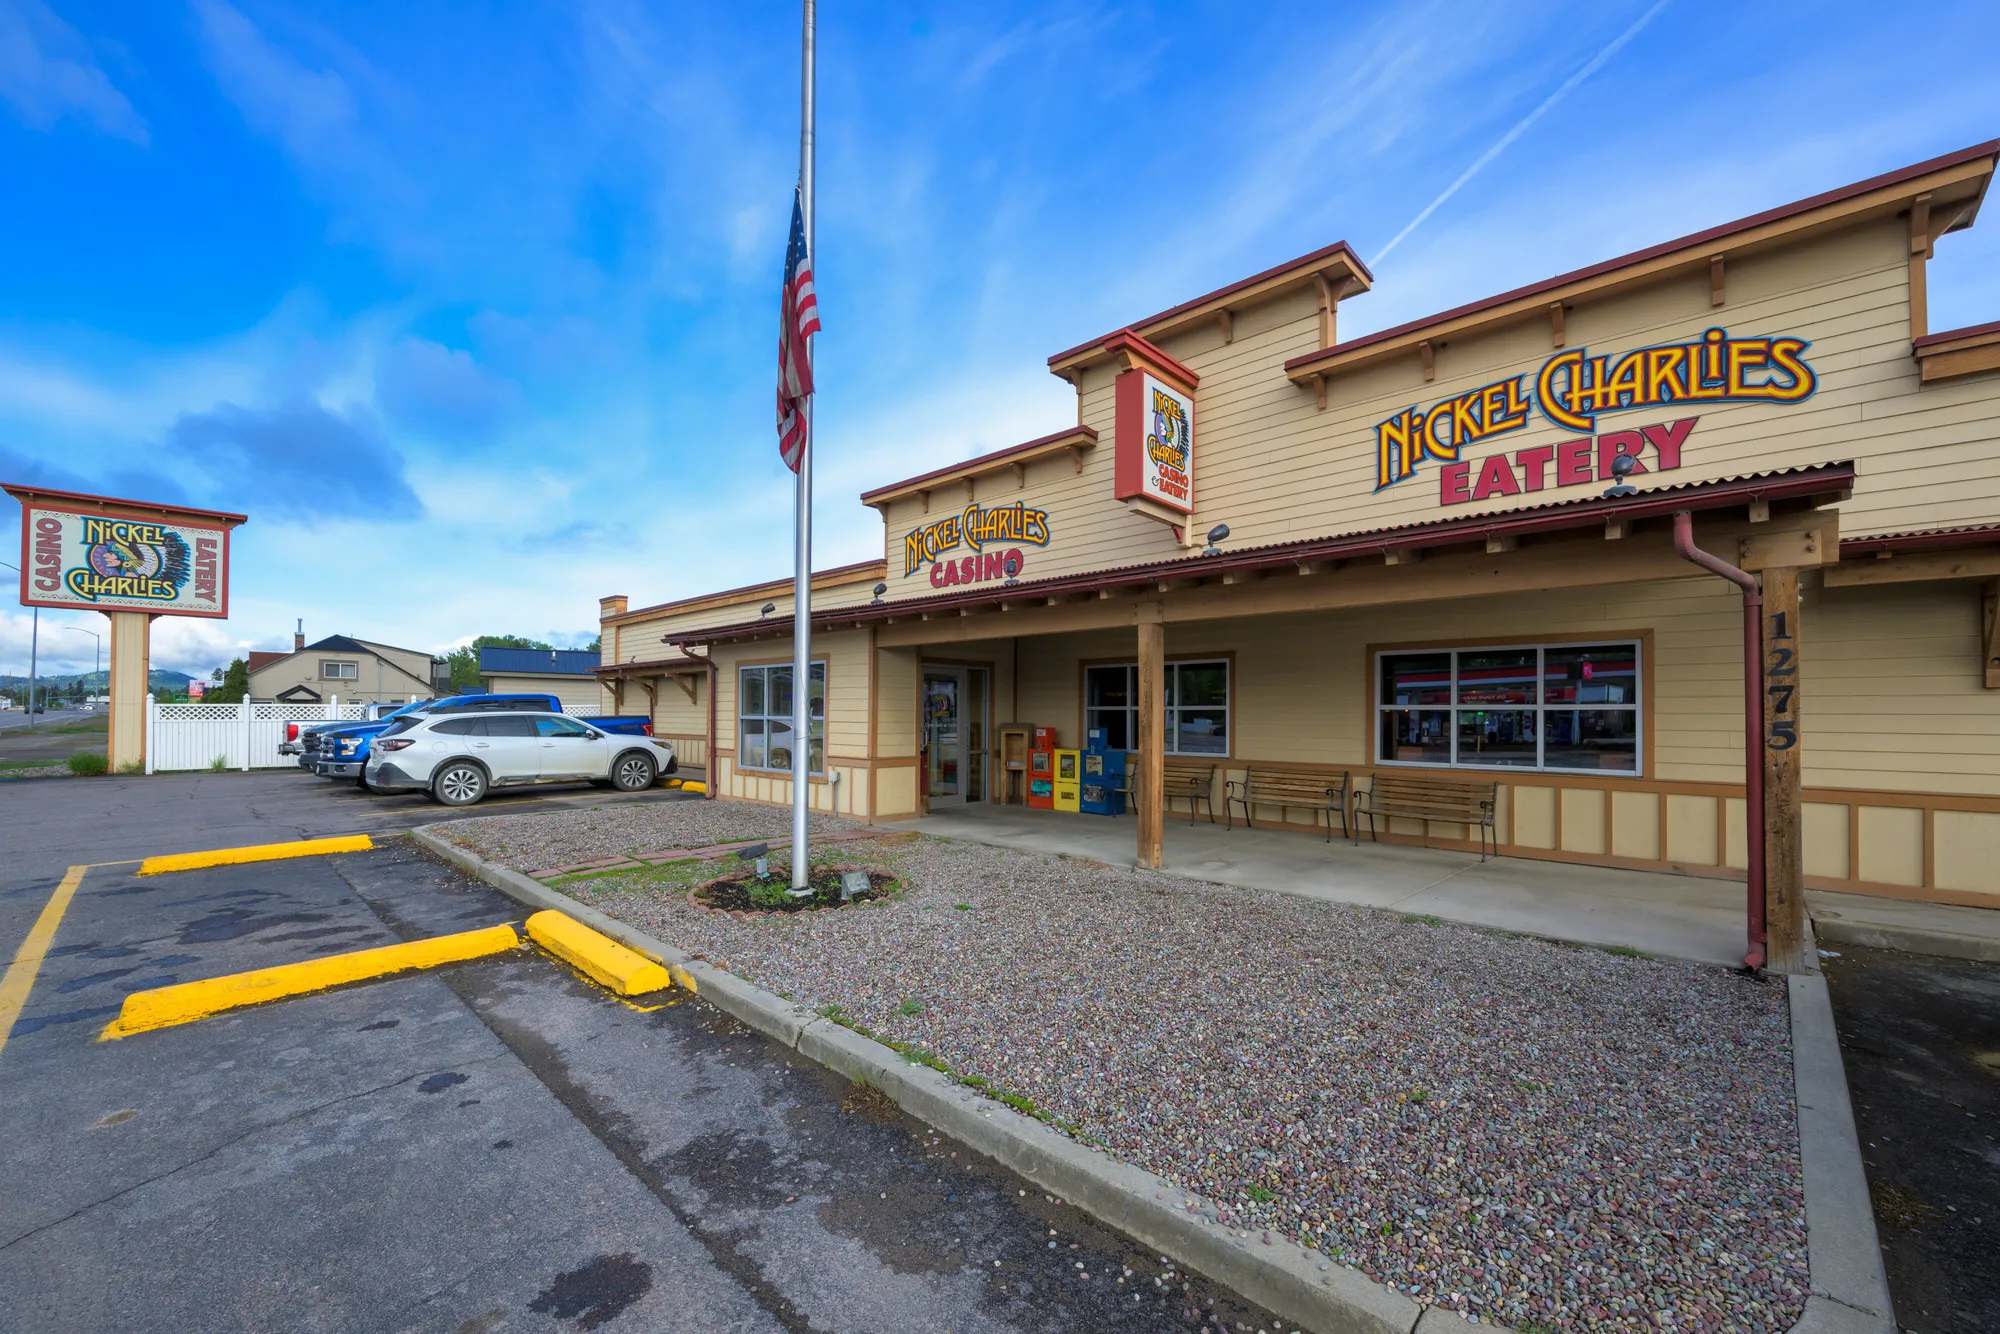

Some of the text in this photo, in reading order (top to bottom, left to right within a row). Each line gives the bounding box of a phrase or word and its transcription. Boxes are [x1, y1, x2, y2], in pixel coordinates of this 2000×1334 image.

[1158, 464, 1189, 488] CASINO
[1159, 477, 1189, 501] EATERY
[1440, 416, 1700, 506] EATERY
[35, 517, 62, 591] CASINO
[195, 537, 217, 603] EATERY
[930, 548, 1024, 589] CASINO
[1768, 611, 1798, 750] 1275
